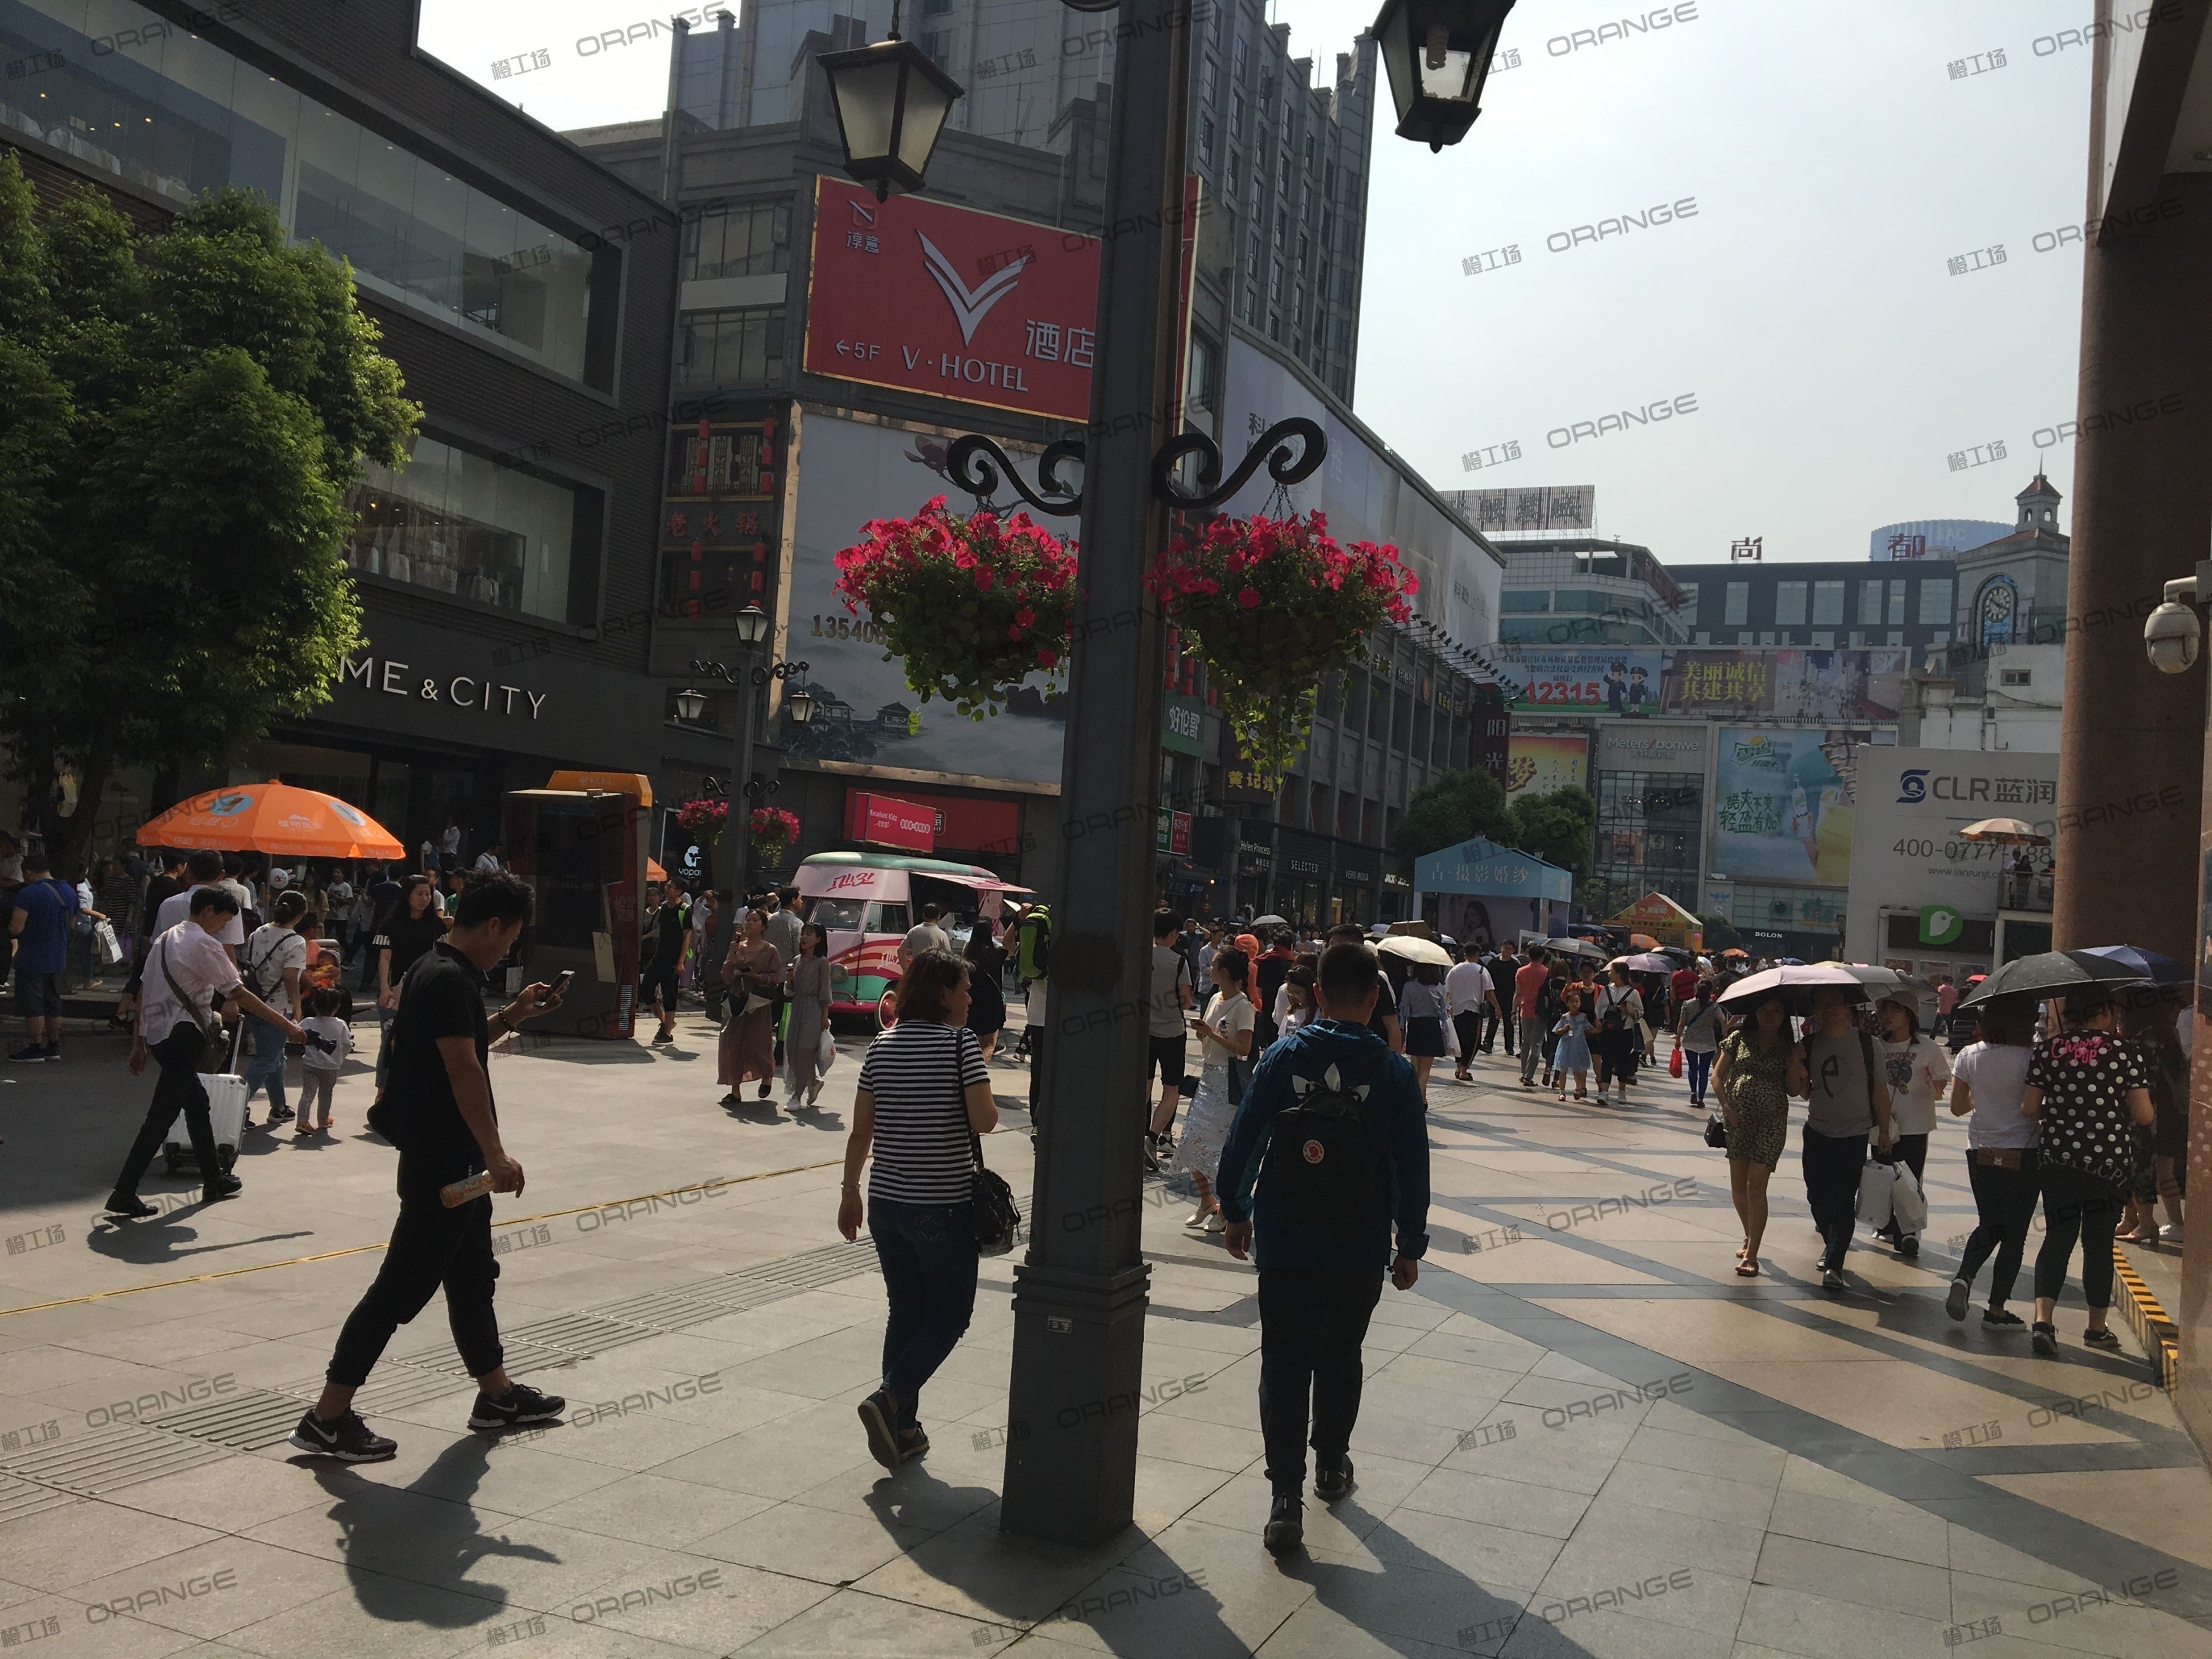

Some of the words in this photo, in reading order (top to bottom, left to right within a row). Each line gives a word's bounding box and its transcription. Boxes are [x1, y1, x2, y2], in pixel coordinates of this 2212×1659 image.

[854, 343, 880, 360] 5F
[1024, 319, 1095, 368] 酒店
[940, 353, 1029, 392] HOTEL
[1730, 536, 1763, 561] 尚
[1887, 533, 1926, 559] 都
[1683, 661, 1767, 683] 美丽诚信
[420, 679, 439, 701] &
[450, 676, 546, 719] CITY
[1524, 681, 1601, 705] 12315
[1680, 681, 1766, 702] 共建共享
[1169, 705, 1201, 741] 好伦哥
[1506, 756, 1538, 793] 梦
[1726, 788, 1775, 813] 酷爽不变
[1932, 776, 1990, 802] CLR
[1994, 777, 2057, 805] 蓝润
[1241, 840, 1254, 853] Helen
[1253, 841, 1271, 855] Princess
[1291, 860, 1319, 873] SELECTED
[1345, 869, 1357, 880] VERO
[1357, 871, 1370, 882] MODA
